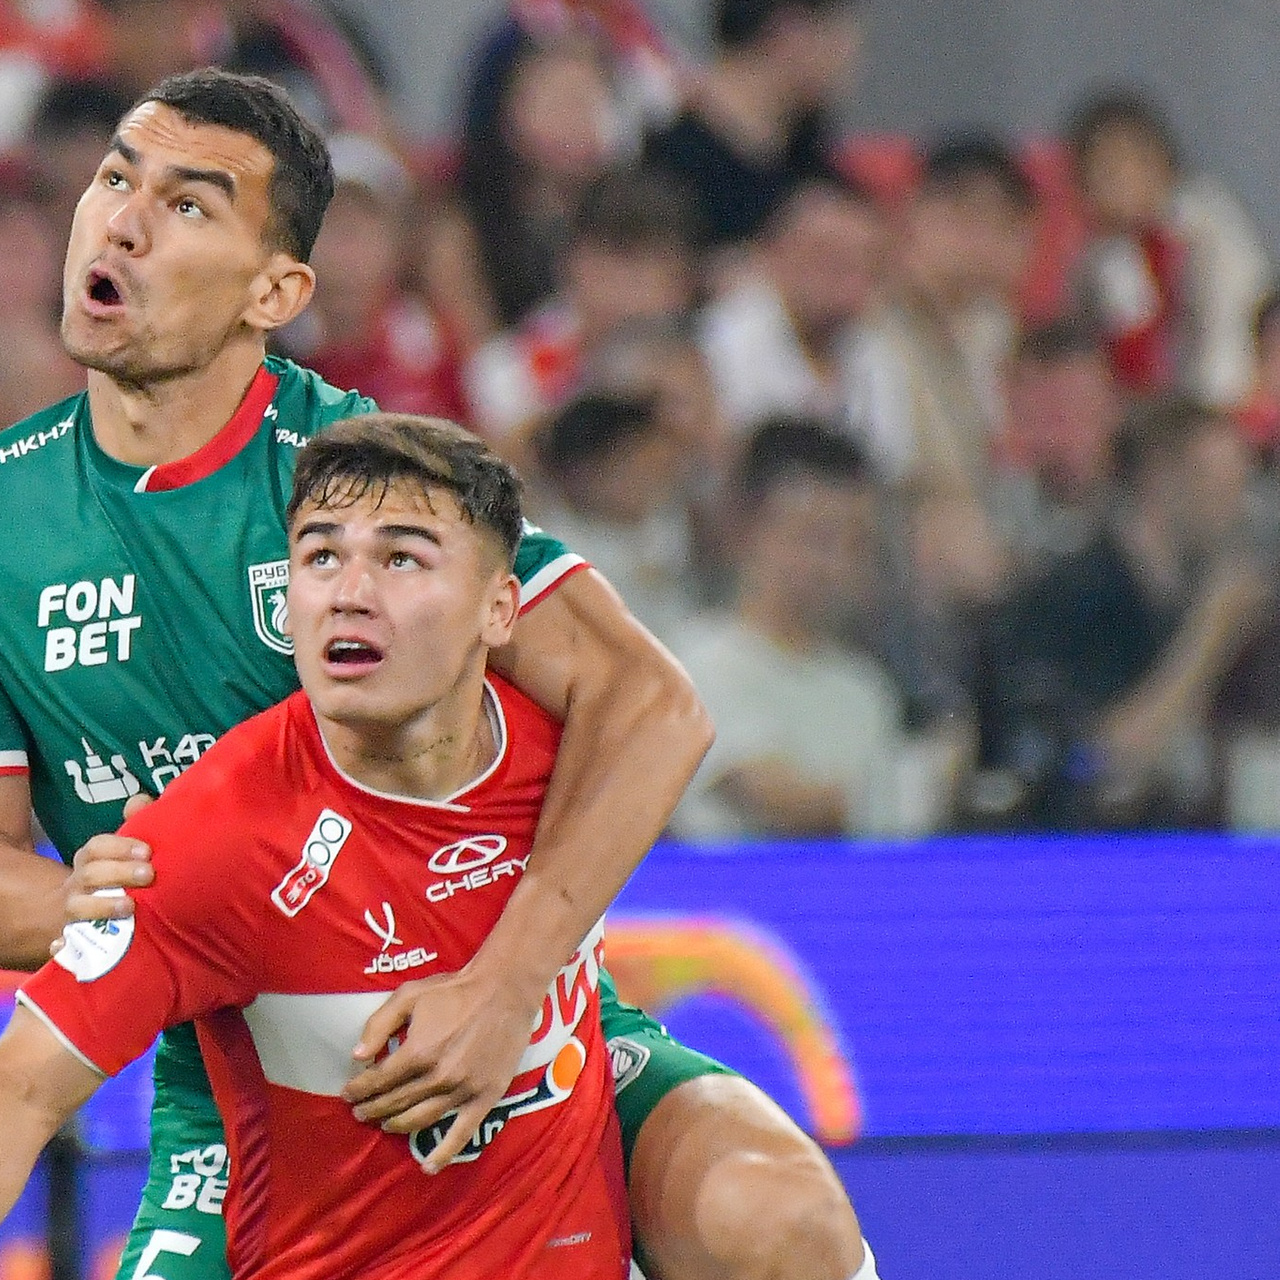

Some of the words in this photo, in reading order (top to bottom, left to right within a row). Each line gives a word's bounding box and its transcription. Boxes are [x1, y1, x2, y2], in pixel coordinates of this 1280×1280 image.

[252, 564, 290, 581] РУБ
[37, 574, 135, 628] FON
[44, 615, 142, 673] BET
[426, 854, 531, 902] CHERY
[363, 947, 438, 975] JÖGEL
